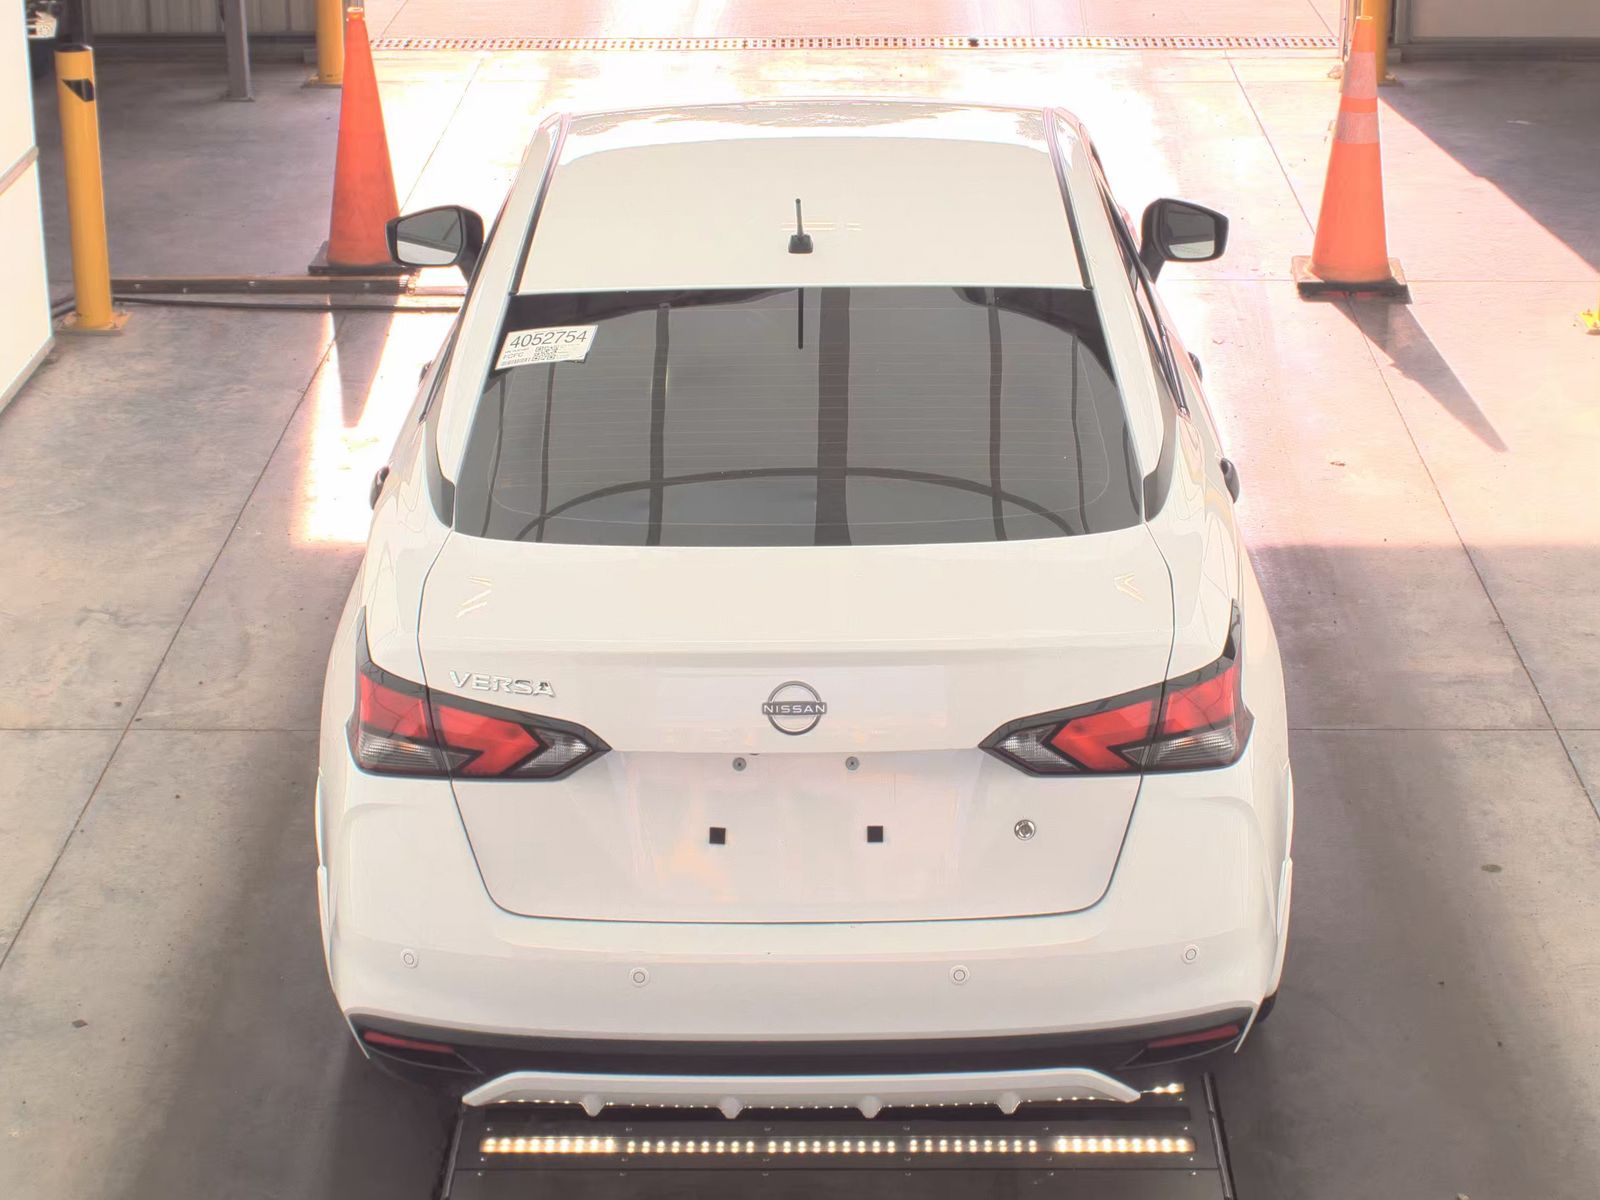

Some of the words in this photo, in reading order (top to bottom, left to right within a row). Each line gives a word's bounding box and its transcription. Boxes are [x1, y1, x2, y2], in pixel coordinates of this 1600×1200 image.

[510, 330, 587, 348] 4052754
[450, 671, 556, 697] VERSA
[763, 704, 825, 713] NISSAN
